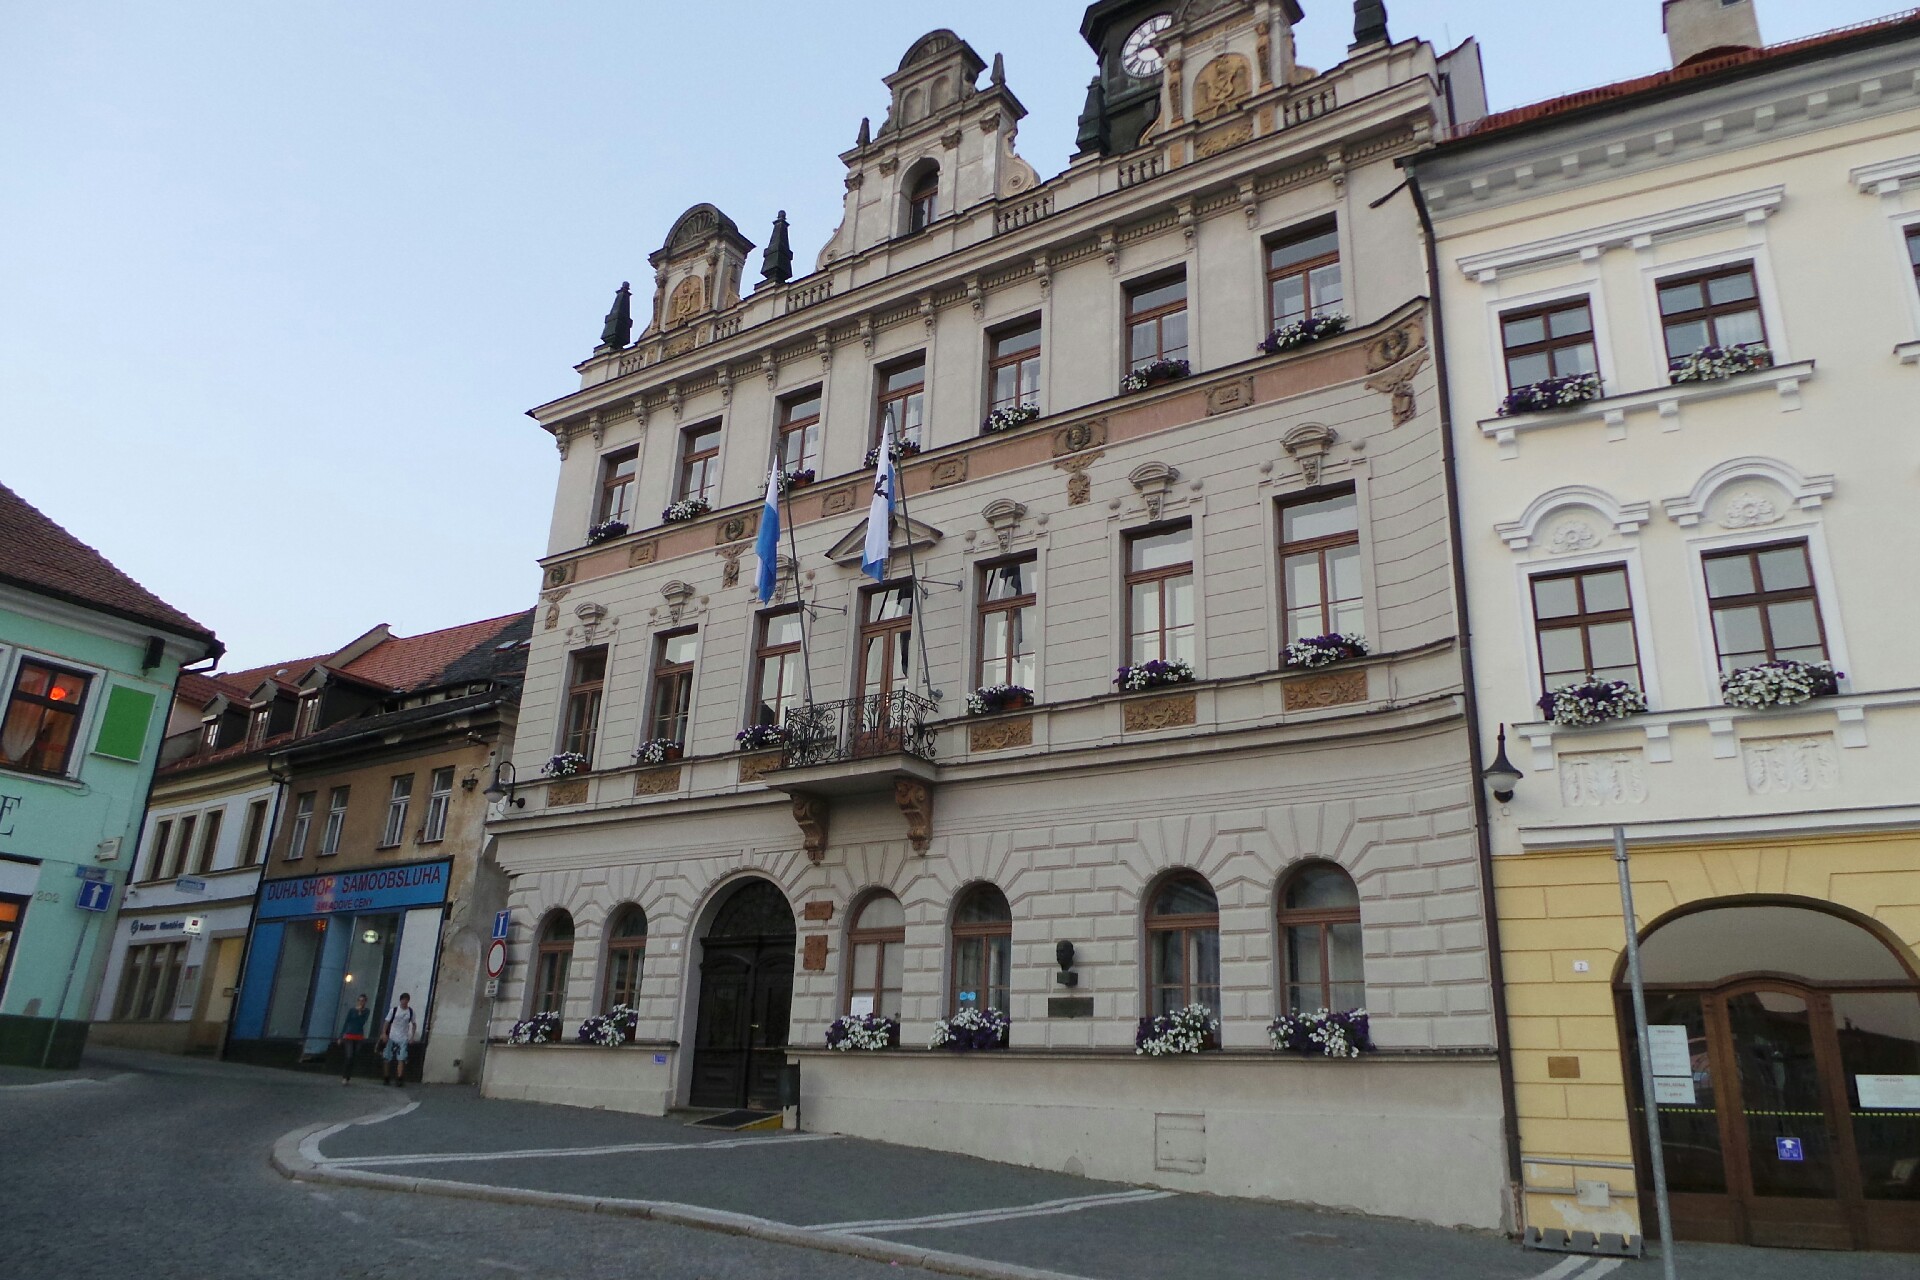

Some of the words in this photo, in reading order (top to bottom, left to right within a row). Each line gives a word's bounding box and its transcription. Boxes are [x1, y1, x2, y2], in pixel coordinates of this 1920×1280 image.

[267, 882, 298, 901] DUHA
[301, 879, 333, 896] SHOP
[342, 866, 441, 894] SAMOOBSLUHA
[37, 890, 60, 903] 202
[354, 898, 373, 909] CENY
